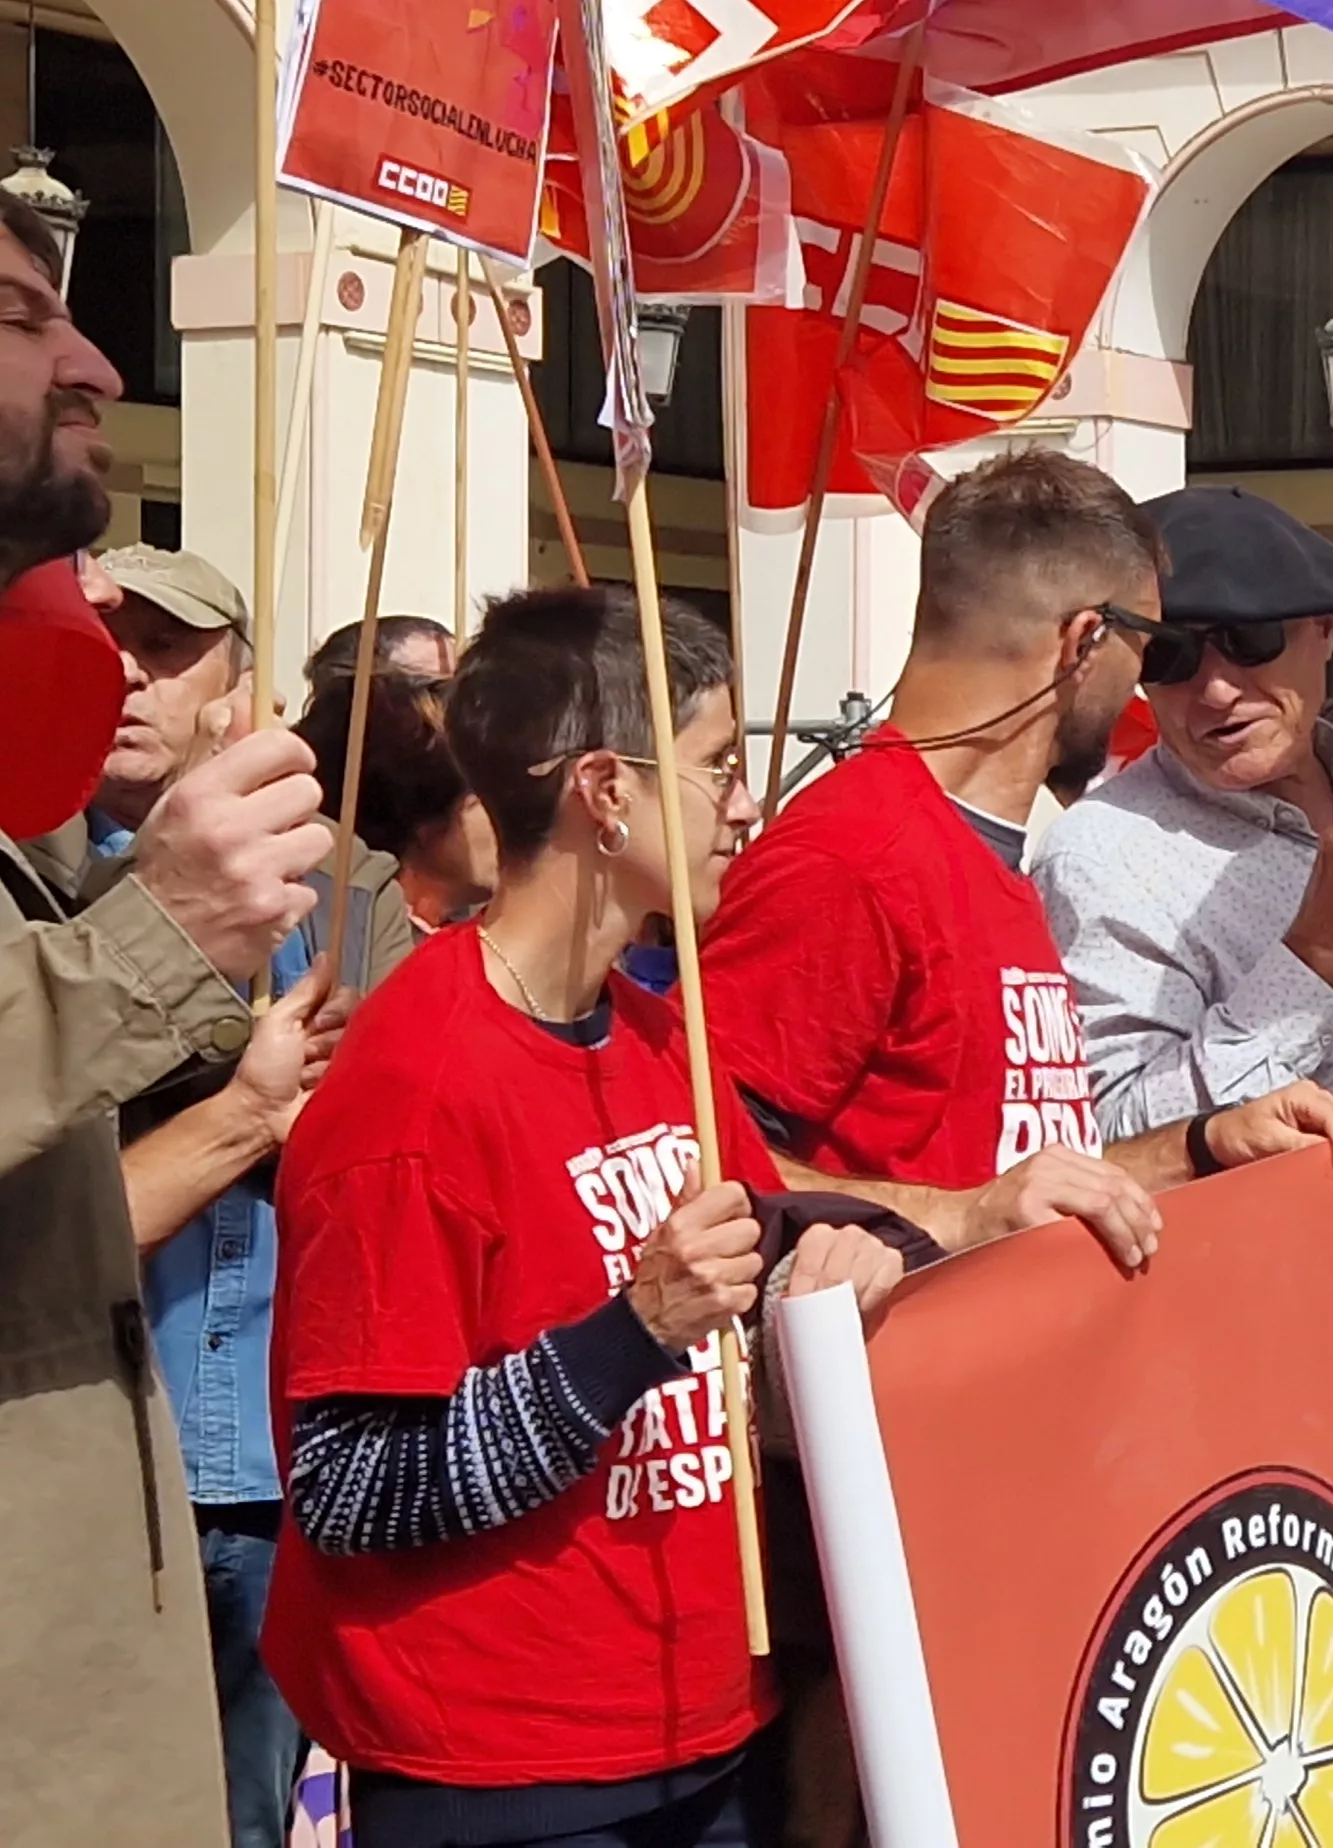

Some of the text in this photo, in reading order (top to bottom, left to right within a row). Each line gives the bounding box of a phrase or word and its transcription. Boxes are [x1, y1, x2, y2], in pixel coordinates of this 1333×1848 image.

[311, 59, 538, 166] #SECTORSOCIALENLUCHA
[378, 160, 449, 208] CCOO
[1098, 1545, 1215, 1731] Aragón
